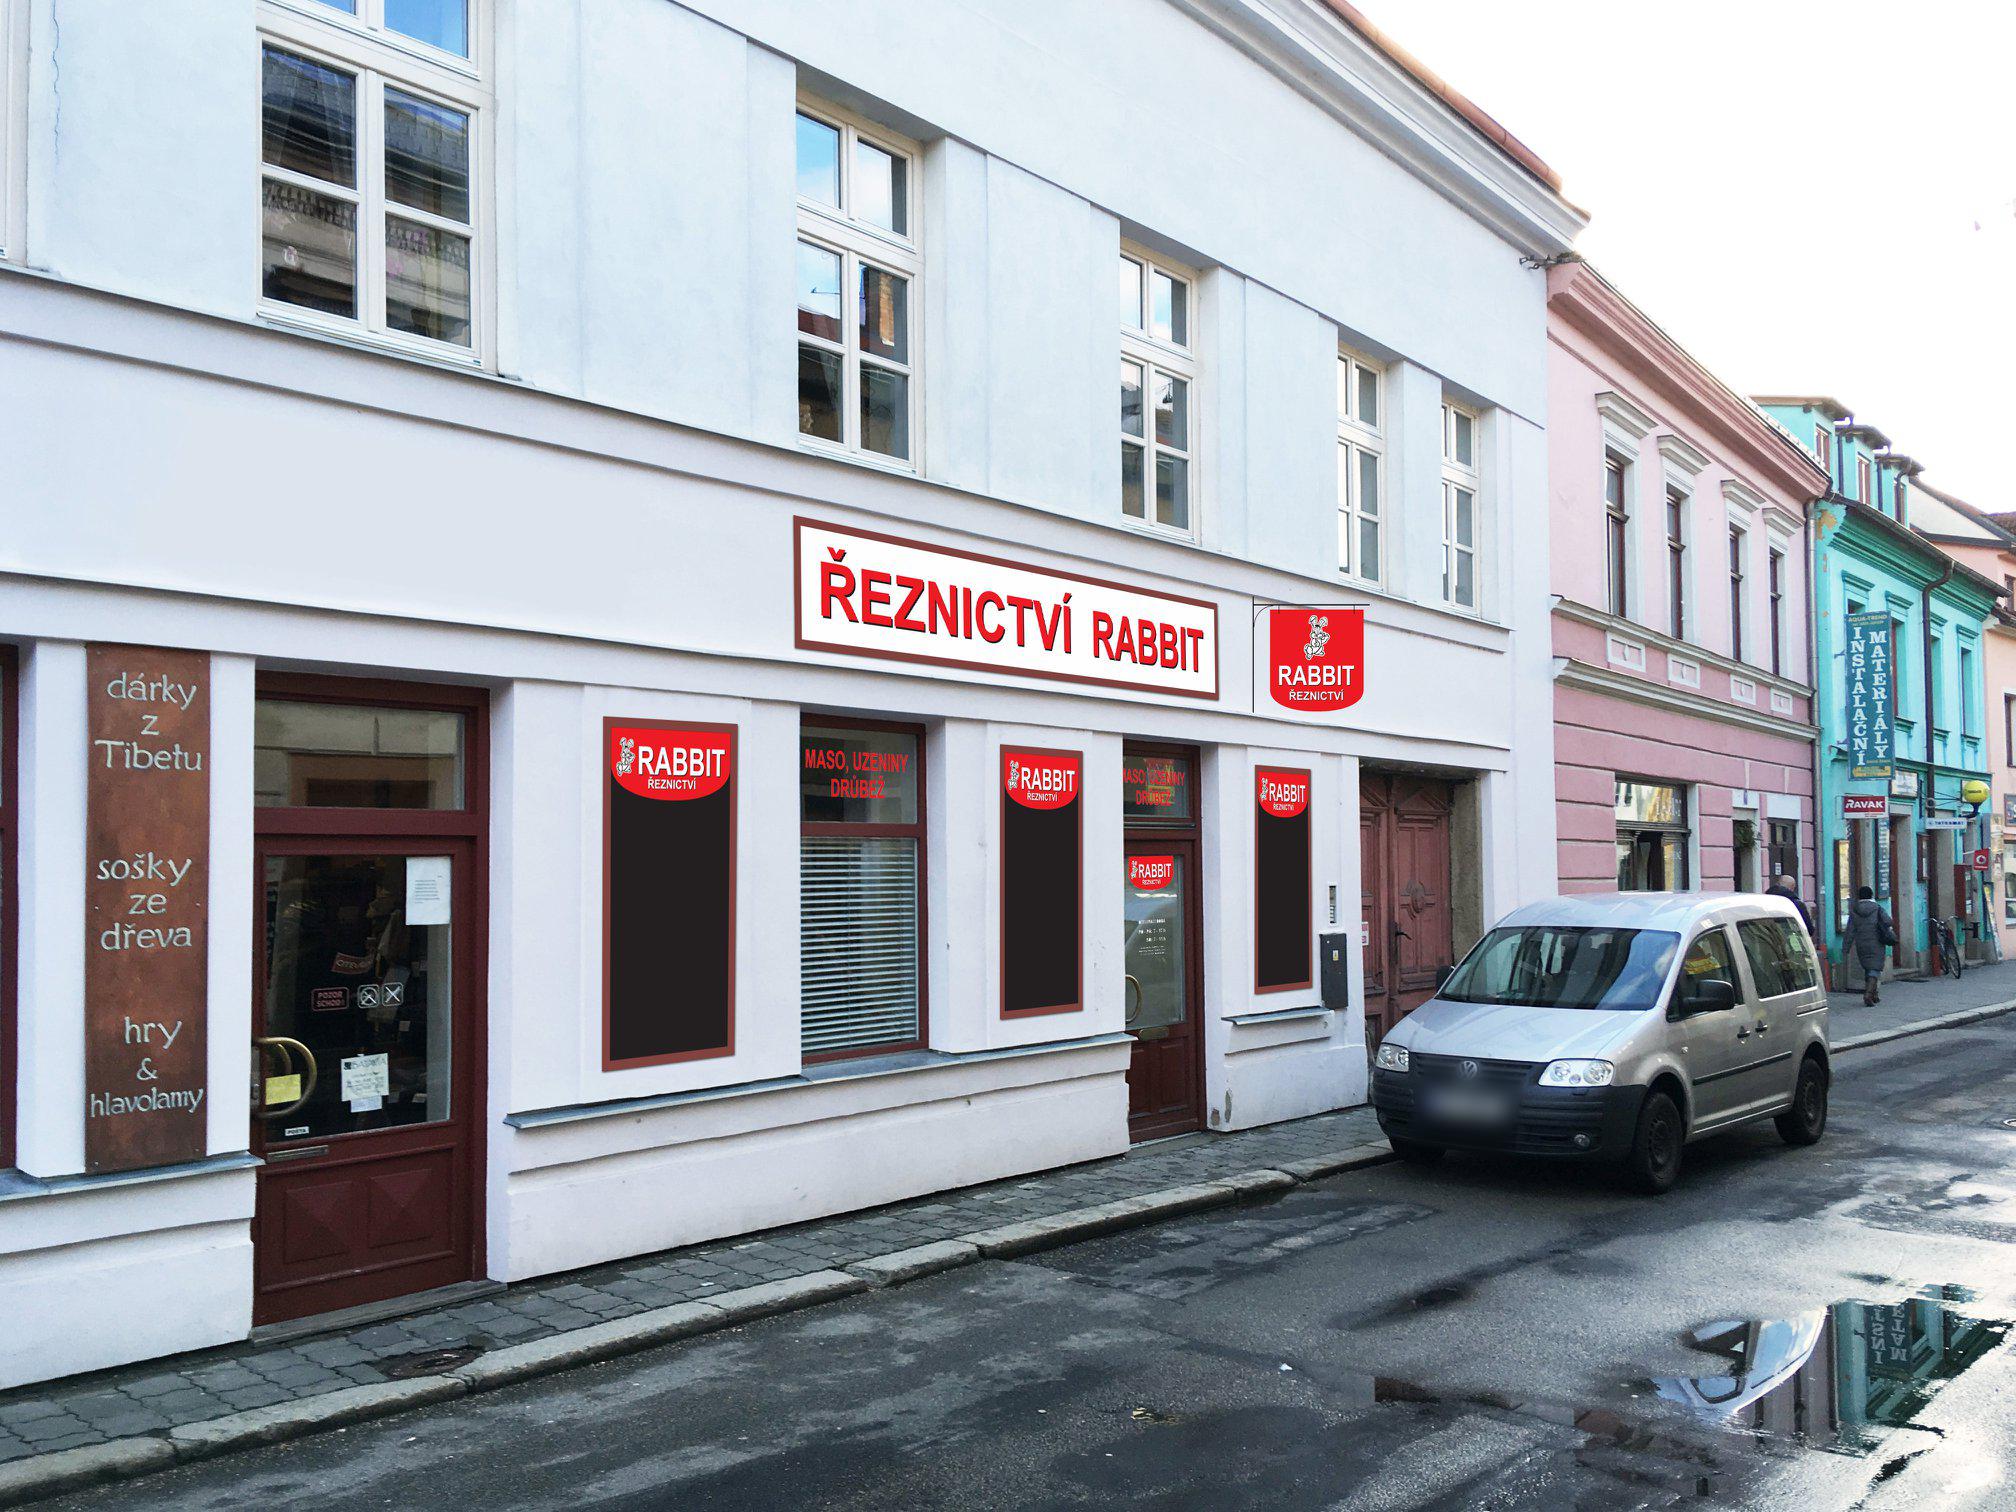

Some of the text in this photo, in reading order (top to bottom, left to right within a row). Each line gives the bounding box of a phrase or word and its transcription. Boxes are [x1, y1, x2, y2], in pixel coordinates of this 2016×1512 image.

[821, 546, 1205, 673] ŘEZNICTVÍ RABBIT
[1278, 665, 1355, 686] RABBIT
[107, 672, 197, 711] dárky
[1289, 689, 1344, 701] ŘEZNICTVÍ
[1850, 626, 1869, 766] INSTALAČNÍ
[1869, 630, 1889, 758] MATERIÁLY
[141, 714, 160, 736] z
[94, 739, 202, 771] Tibetu
[638, 746, 726, 777] RABBIT
[805, 748, 909, 774] MASO, UZENINY
[647, 777, 697, 790] ŘEZNICTVÍ
[830, 774, 886, 799] DRŮBEŽ
[1021, 767, 1075, 792] RABBIT
[1026, 790, 1058, 802] ŘEZNICTVÍ
[1269, 782, 1306, 803] RABBIT
[1845, 799, 1884, 809] RAVAK
[97, 851, 192, 887] sošky
[1138, 863, 1172, 878] RABBIT
[128, 893, 167, 914] ze
[101, 922, 193, 951] dřeva
[317, 991, 343, 999] POZOR
[124, 1016, 183, 1050] hry
[136, 1057, 159, 1081] &
[90, 1086, 204, 1118] hlavolamy
